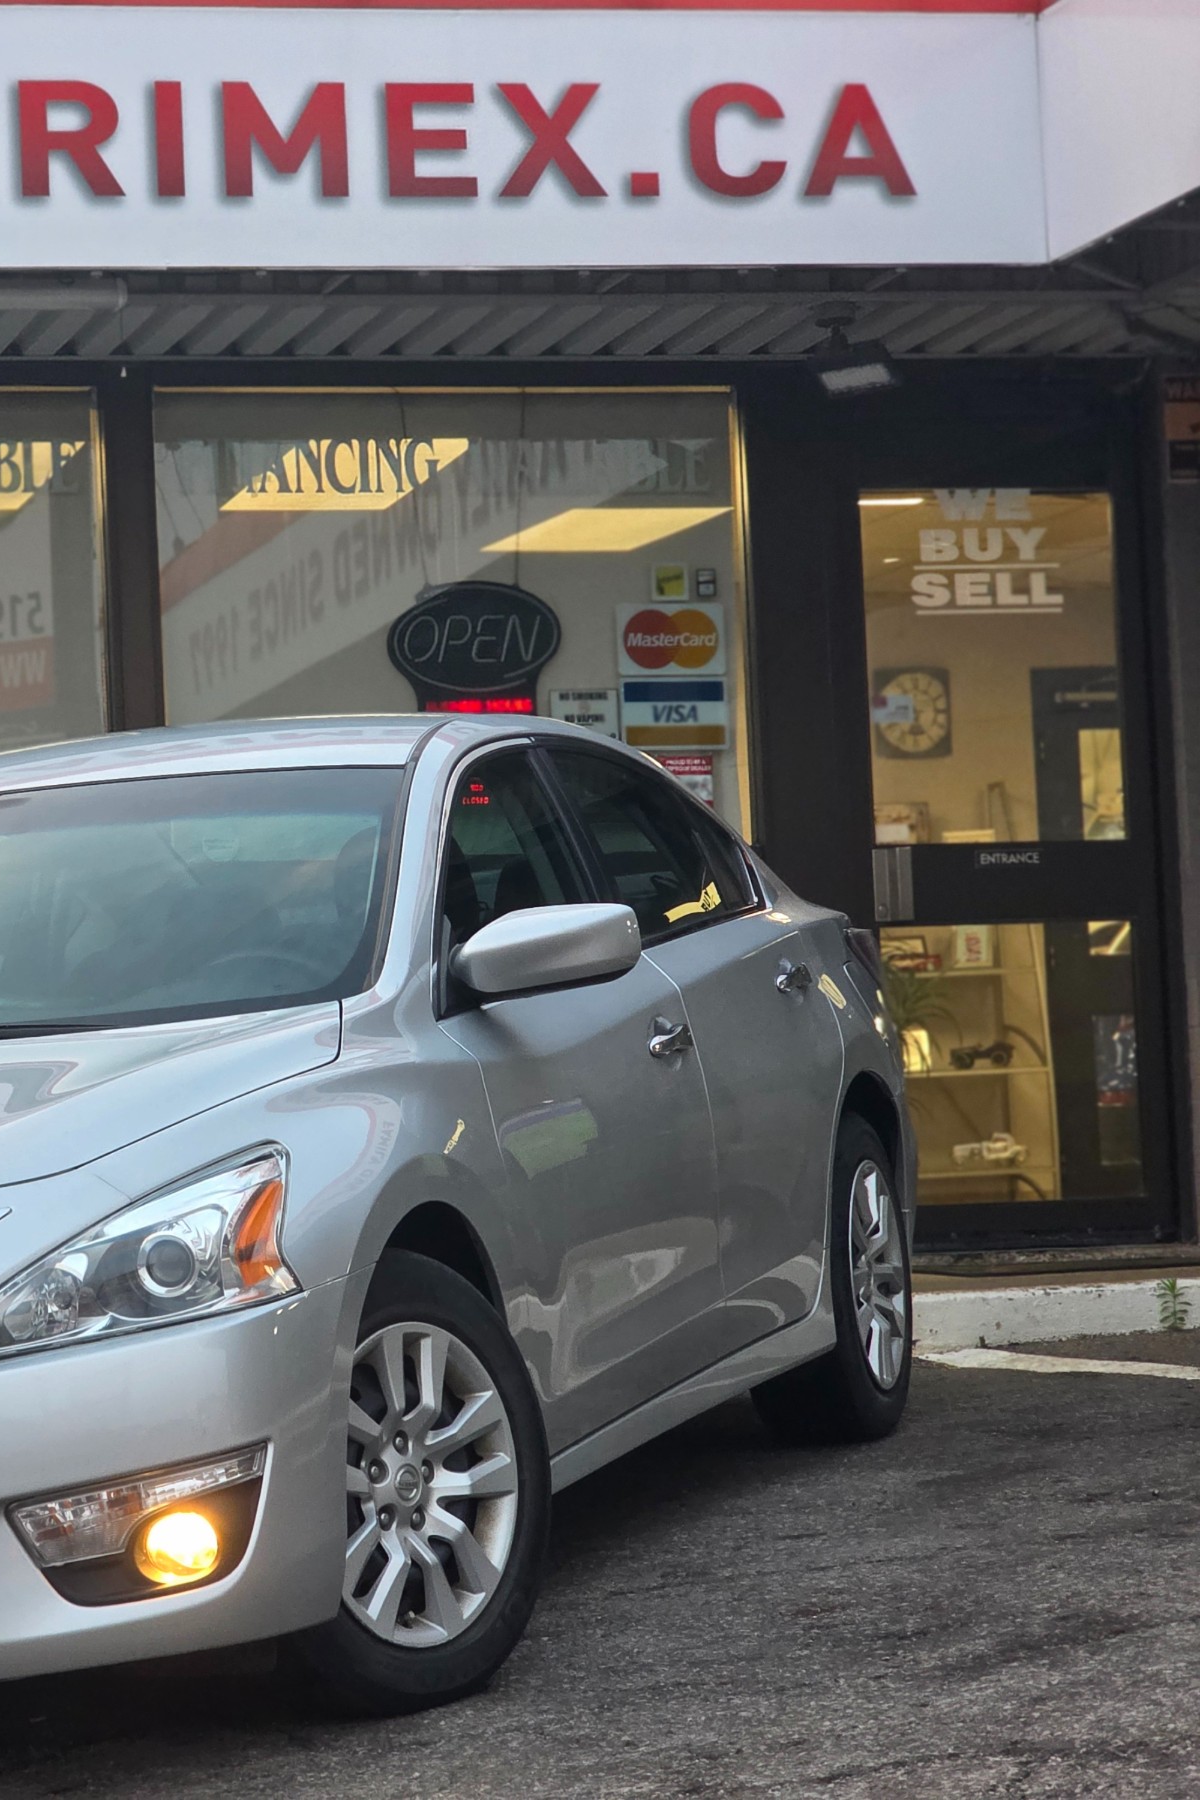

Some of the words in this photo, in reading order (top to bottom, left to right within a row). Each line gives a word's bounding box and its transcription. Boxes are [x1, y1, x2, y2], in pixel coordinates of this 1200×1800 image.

[933, 487, 1032, 522] WE
[918, 527, 1048, 562] BUY
[910, 571, 1065, 607] SELL
[403, 614, 541, 664] OPEN
[626, 631, 717, 649] MasterCard
[652, 704, 699, 723] VISA
[980, 851, 1040, 865] ENTRANCE
